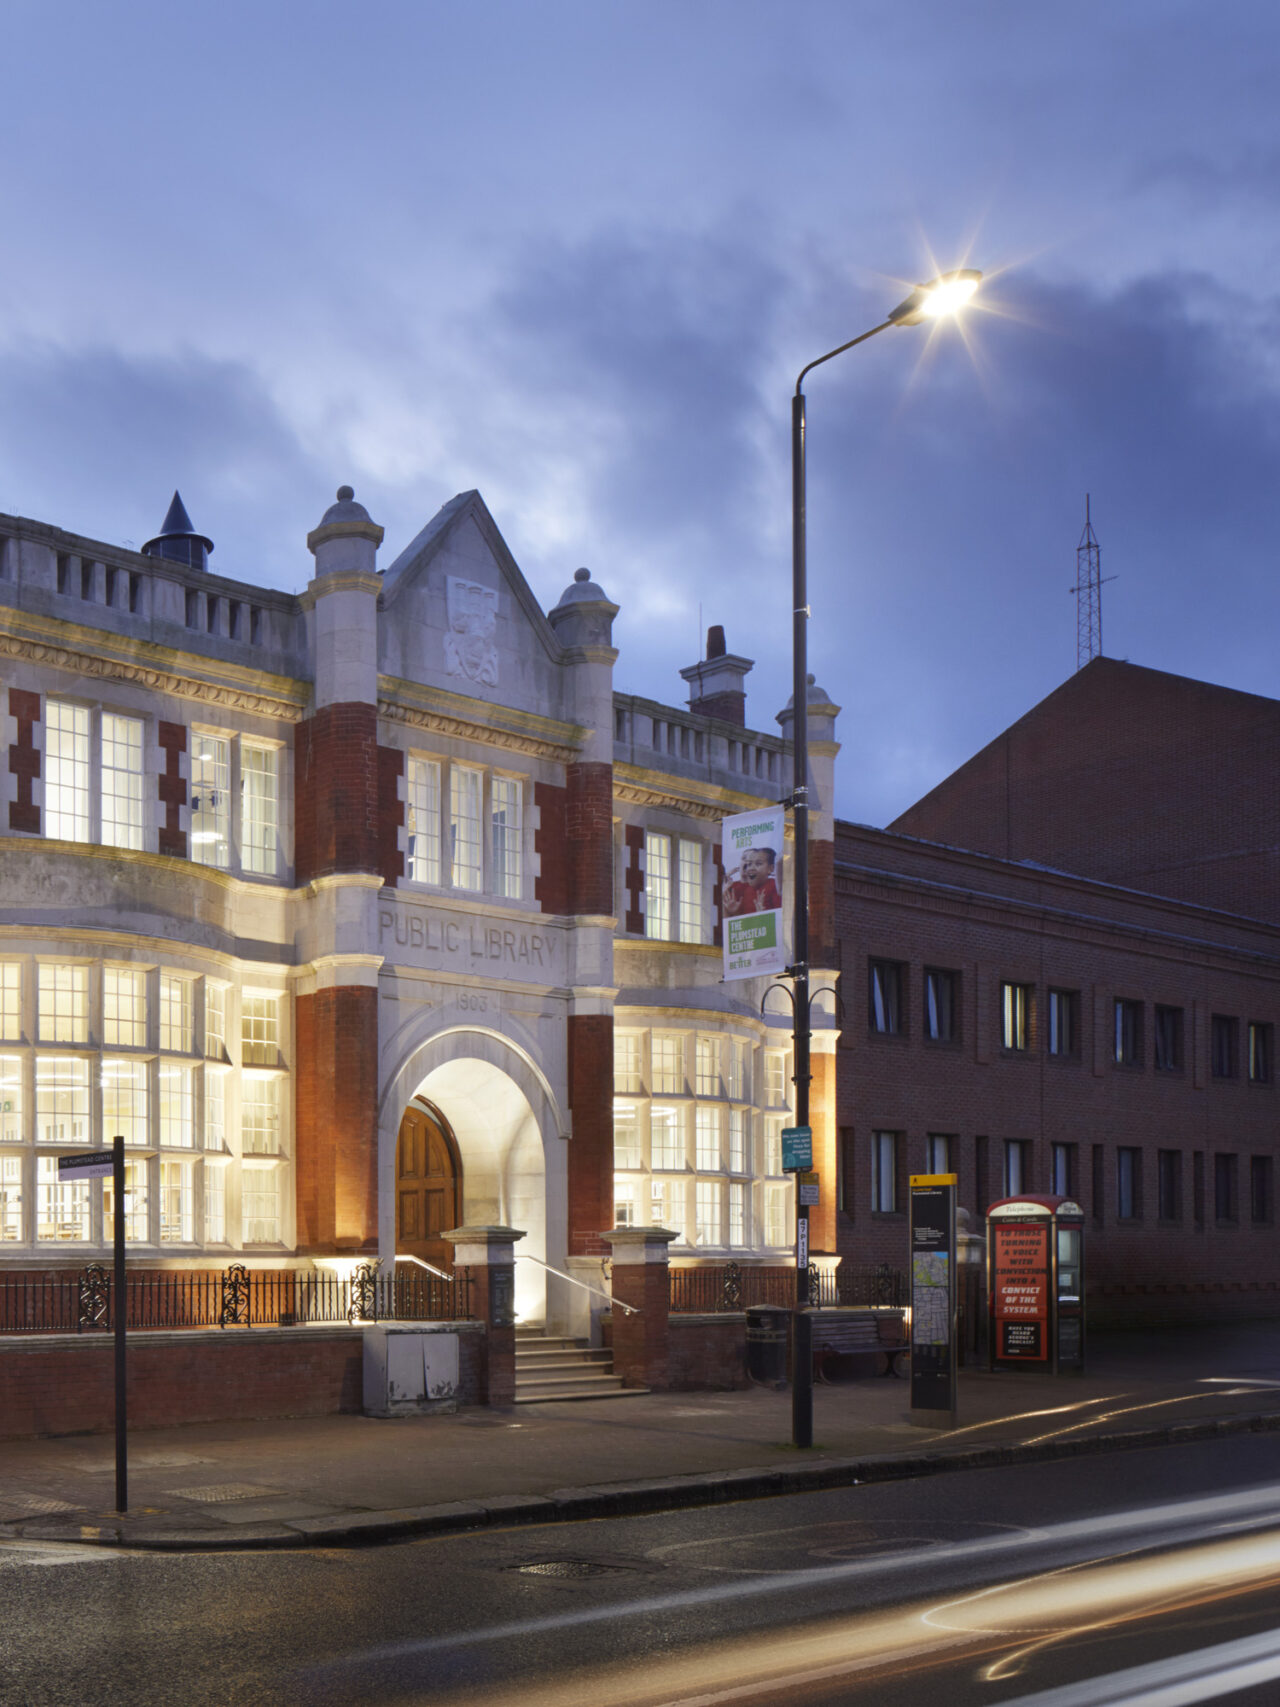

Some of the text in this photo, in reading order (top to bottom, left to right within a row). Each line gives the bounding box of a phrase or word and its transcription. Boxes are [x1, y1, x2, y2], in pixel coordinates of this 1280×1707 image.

[731, 821, 775, 840] PERFORMING
[736, 836, 753, 849] ARTS
[731, 920, 742, 931] THE
[379, 911, 557, 968] PUBLIC LIBRARY
[731, 927, 767, 942] PLUMSTEAD
[731, 939, 755, 952] CENTRE
[456, 992, 488, 1013] 1903
[1001, 1286, 1040, 1294] CONVICT
[1003, 1306, 1038, 1314] SYSTEM
